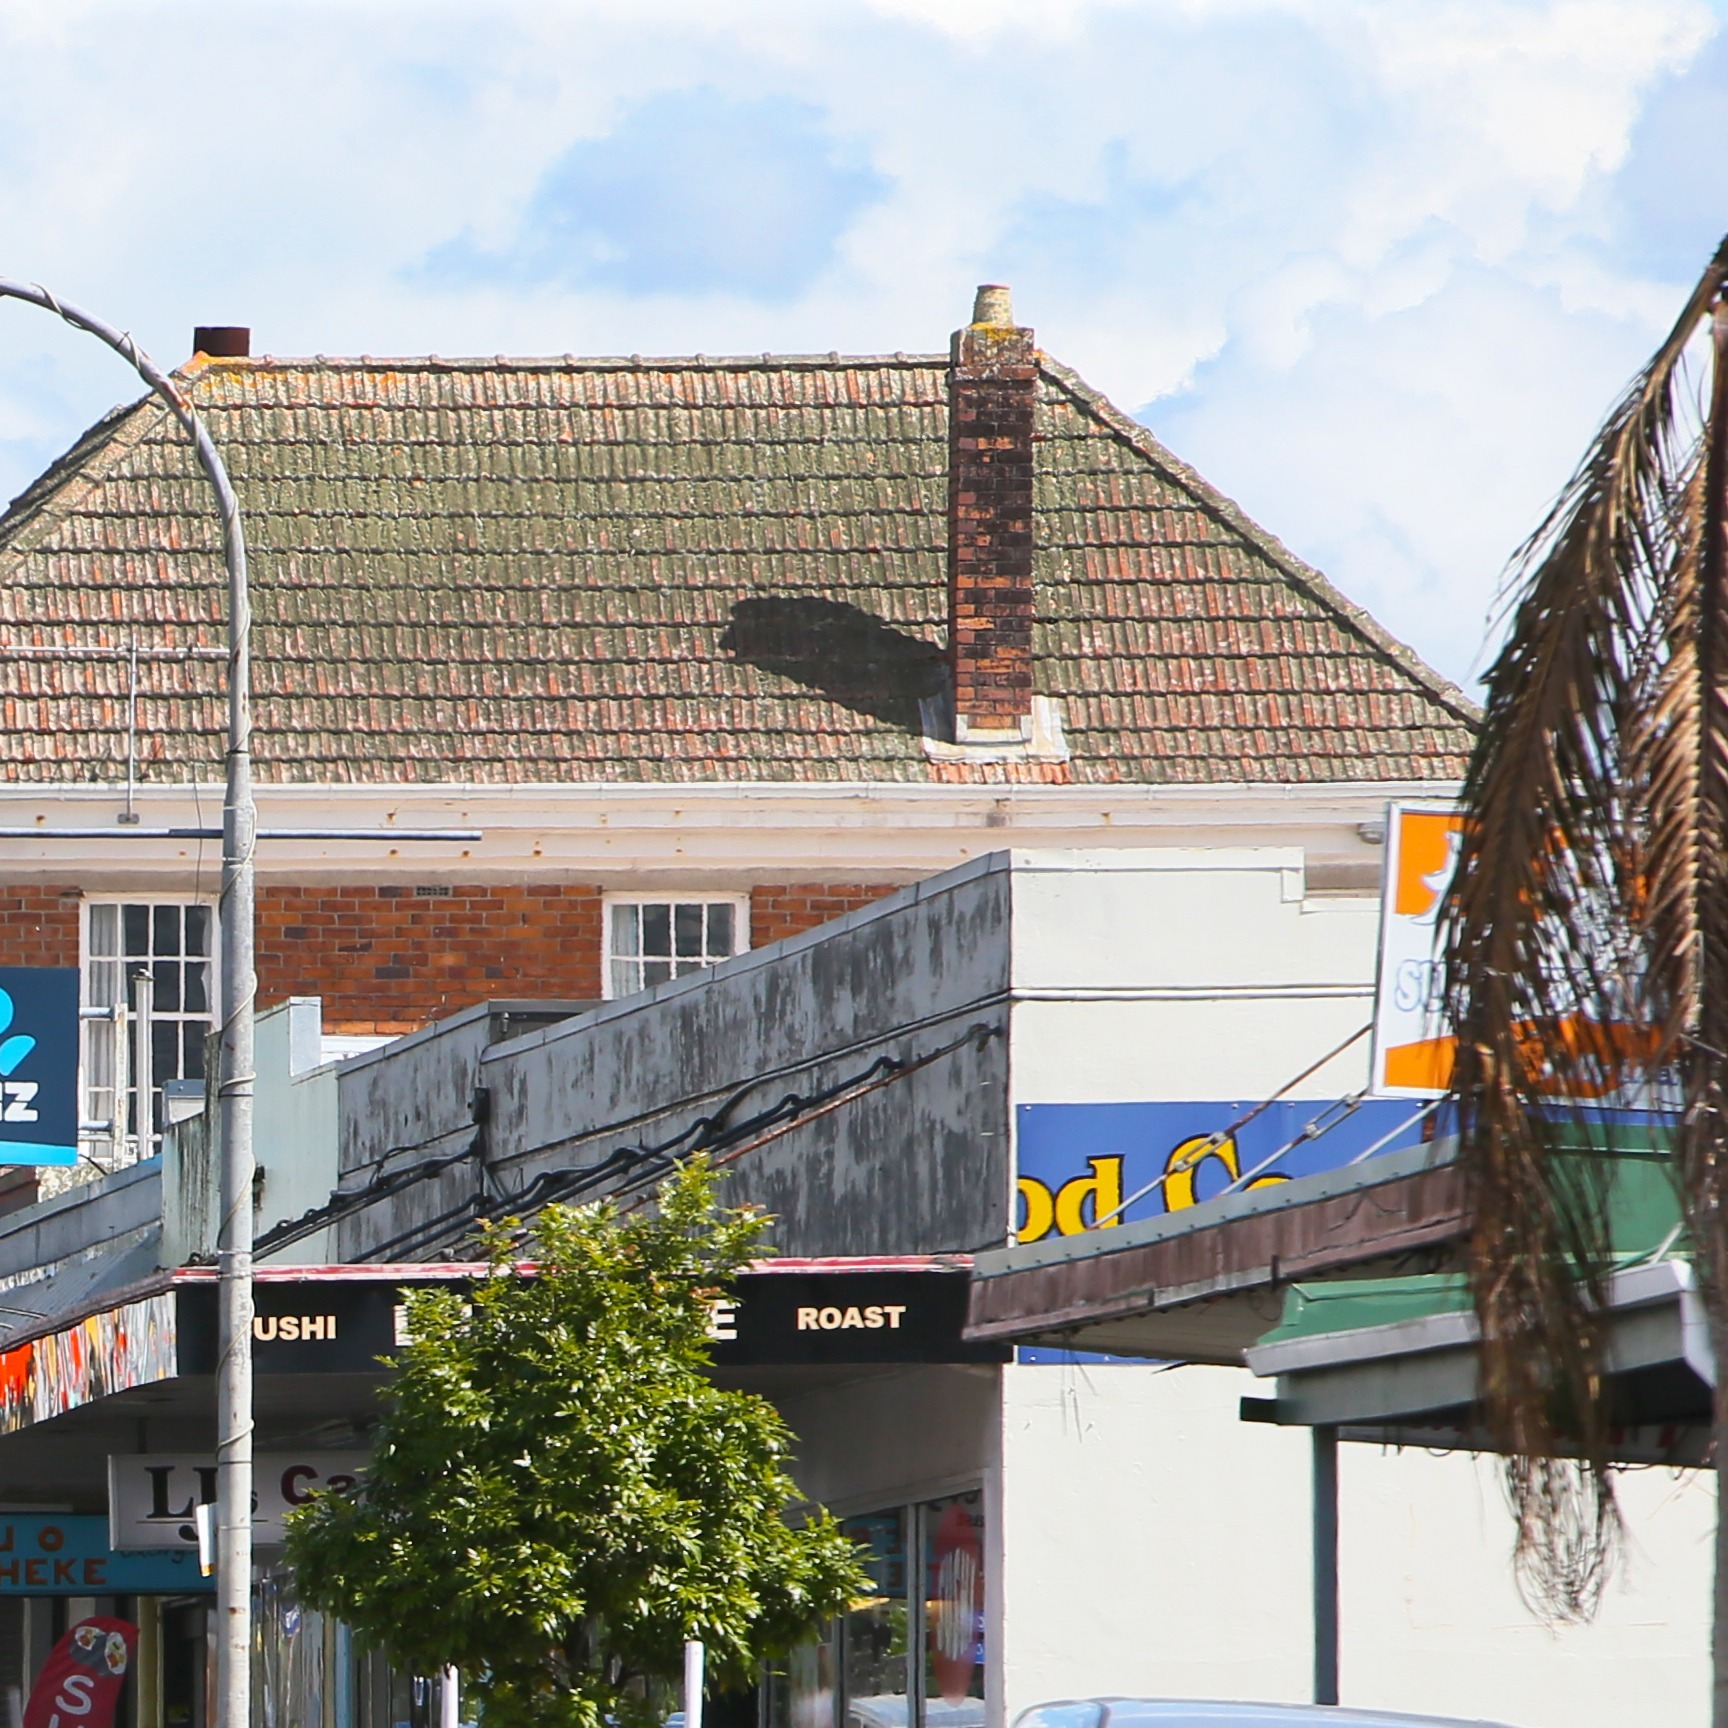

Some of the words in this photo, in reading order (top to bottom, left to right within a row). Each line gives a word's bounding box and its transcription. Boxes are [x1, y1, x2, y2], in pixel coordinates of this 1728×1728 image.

[253, 1314, 338, 1342] USHI
[796, 1305, 907, 1332] ROAST
[38, 1526, 65, 1552] O
